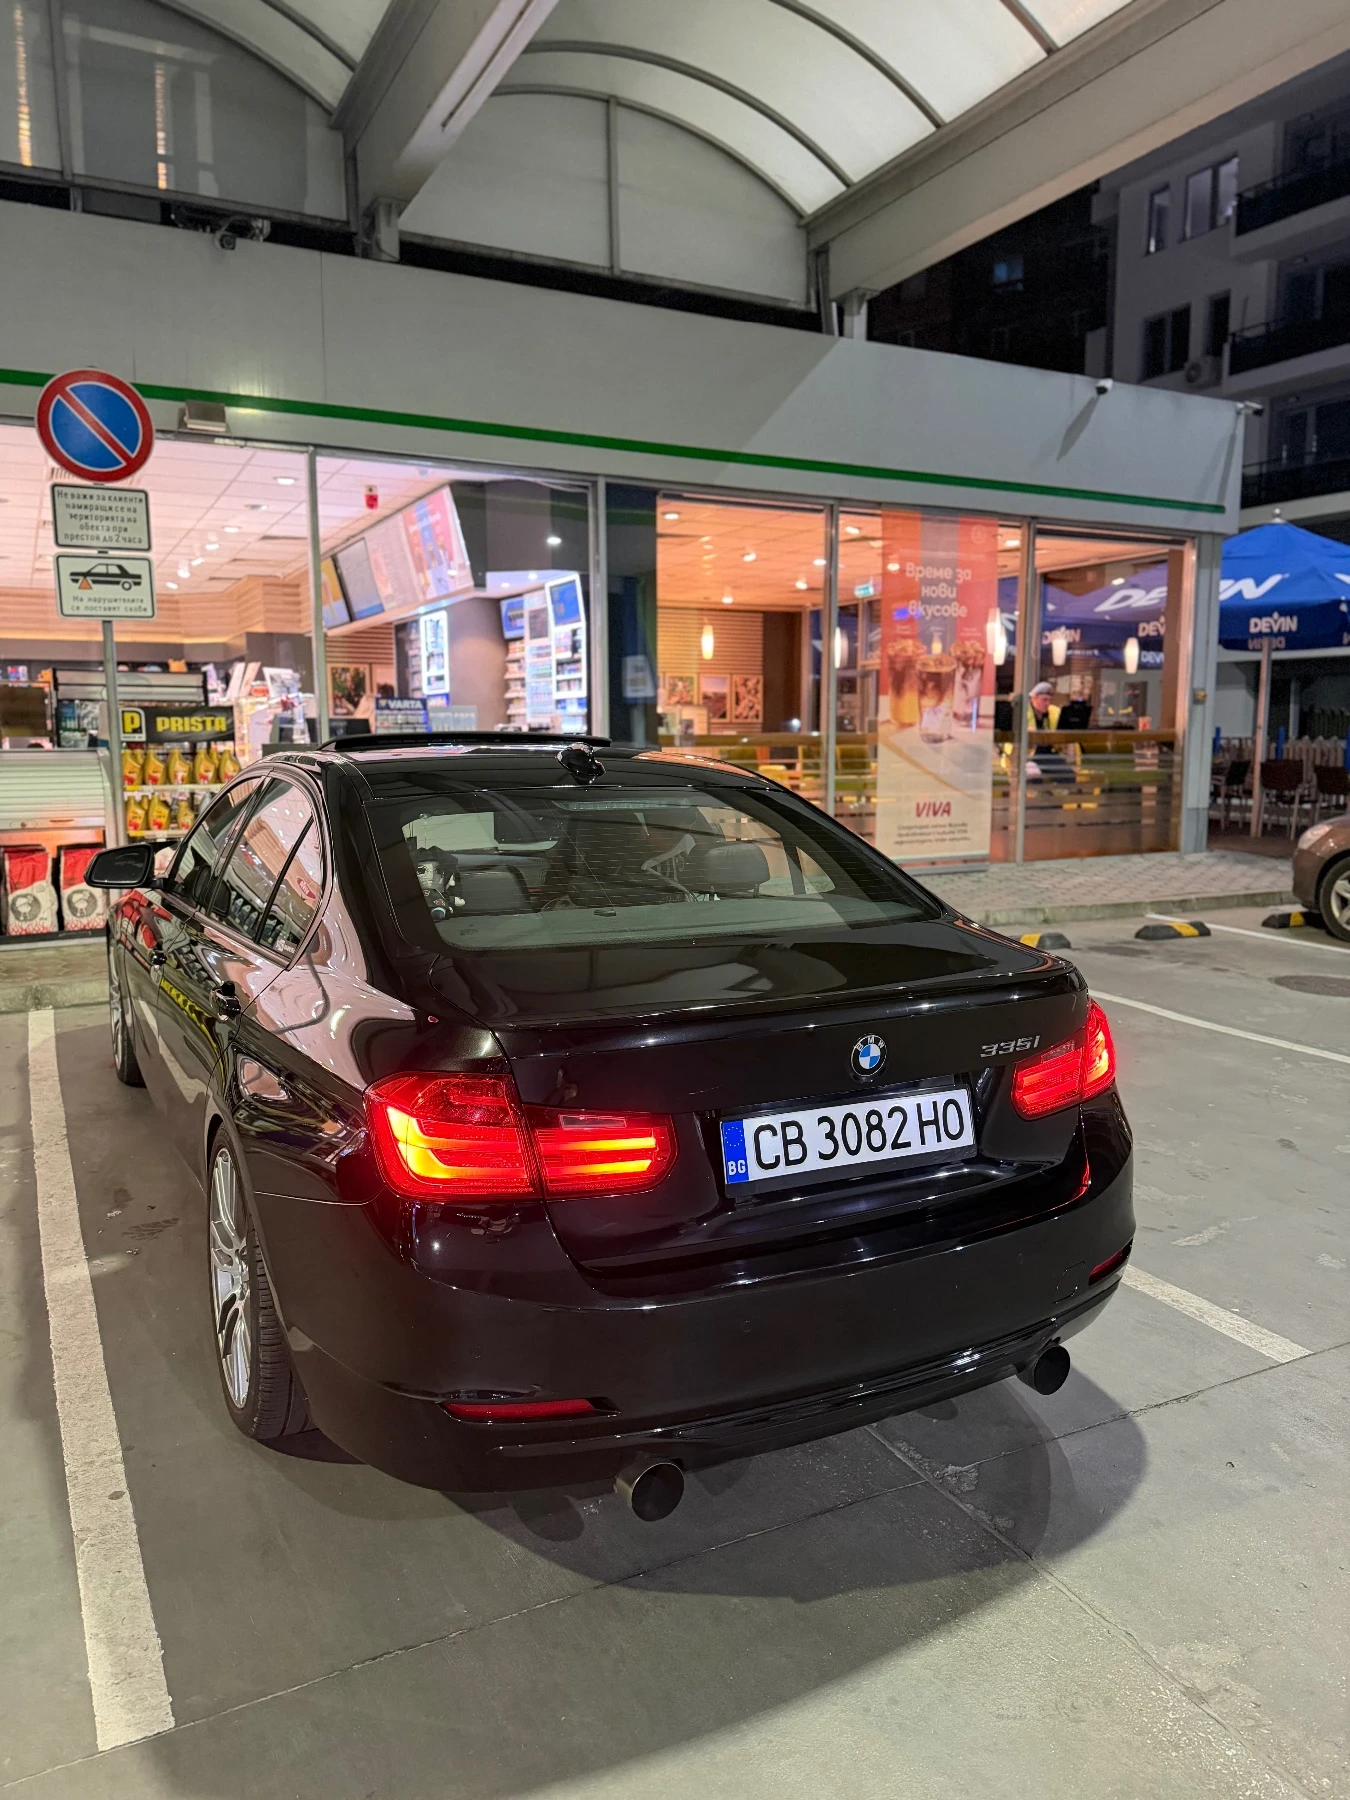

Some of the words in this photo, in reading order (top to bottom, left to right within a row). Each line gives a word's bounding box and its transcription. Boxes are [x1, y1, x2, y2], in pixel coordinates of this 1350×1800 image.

[57, 489, 68, 499] Не
[70, 492, 94, 500] важи
[108, 495, 143, 503] клиенти
[79, 523, 111, 532] обекта
[112, 525, 128, 533] при
[115, 534, 120, 542] 2
[121, 536, 143, 544] часа
[905, 562, 953, 581] Време
[955, 568, 972, 584] за
[921, 582, 957, 598] нови
[1249, 613, 1298, 633] DEVIN
[388, 699, 424, 709] VARTA
[123, 711, 141, 733] P
[155, 716, 227, 732] PRISTA
[916, 801, 951, 818] VIVA
[727, 1159, 746, 1176] BG
[817, 1106, 912, 1161] 3082
